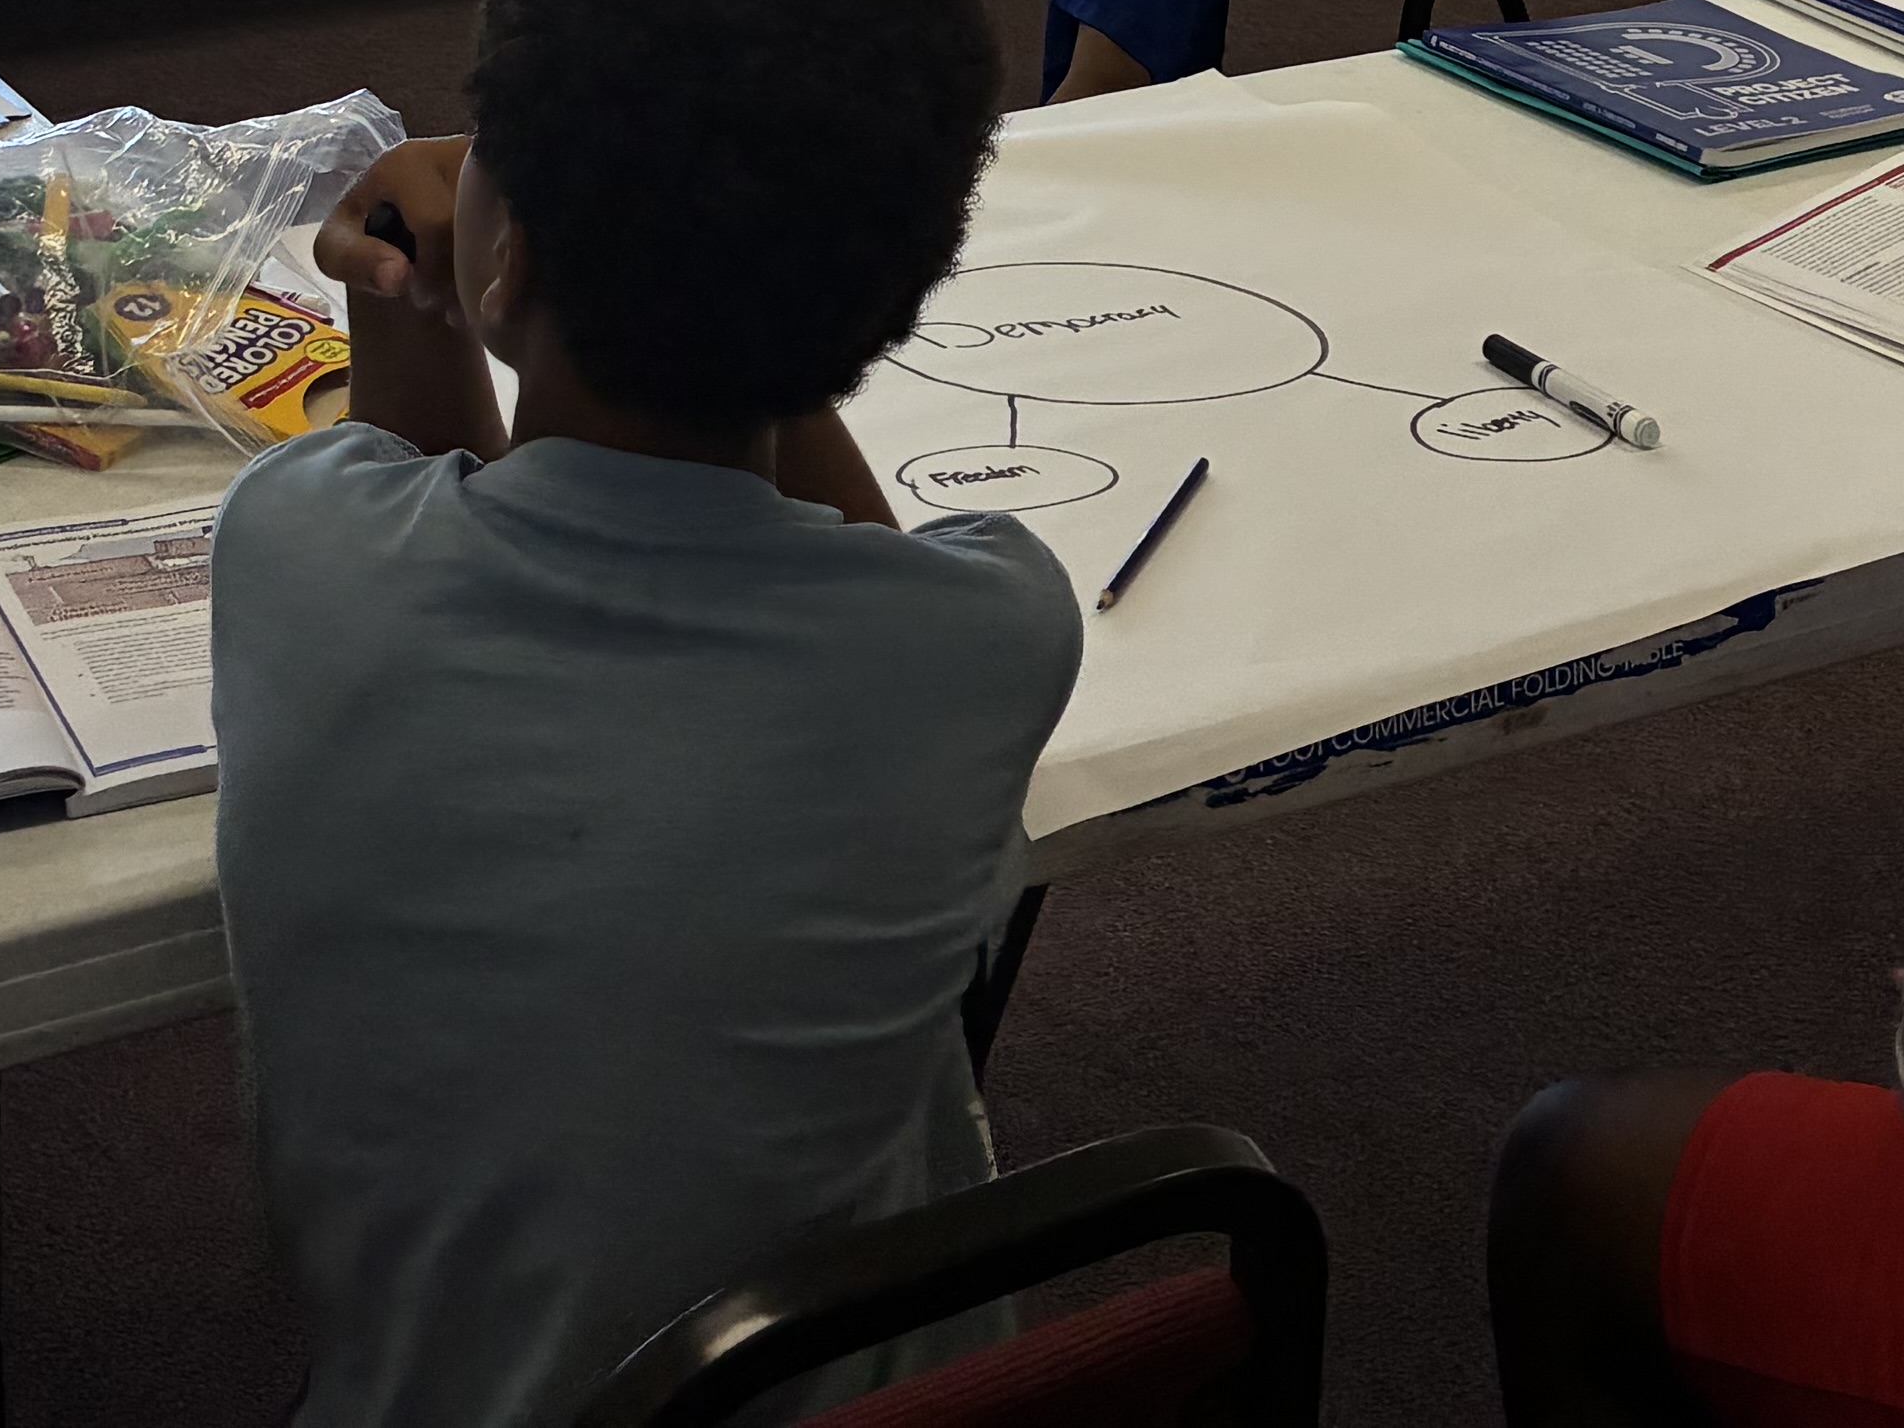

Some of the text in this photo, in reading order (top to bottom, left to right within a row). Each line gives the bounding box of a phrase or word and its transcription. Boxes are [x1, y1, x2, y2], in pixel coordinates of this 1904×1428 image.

[1713, 73, 1852, 97] PROJECT
[1738, 83, 1861, 106] CITIZEN
[1694, 115, 1809, 137] LEVEL 2
[124, 296, 163, 317] 12
[912, 304, 1181, 349] Democracy
[199, 318, 313, 395] COLORED
[1332, 685, 1505, 750] COMMERCIAL
[1512, 656, 1616, 700] FOLDING
